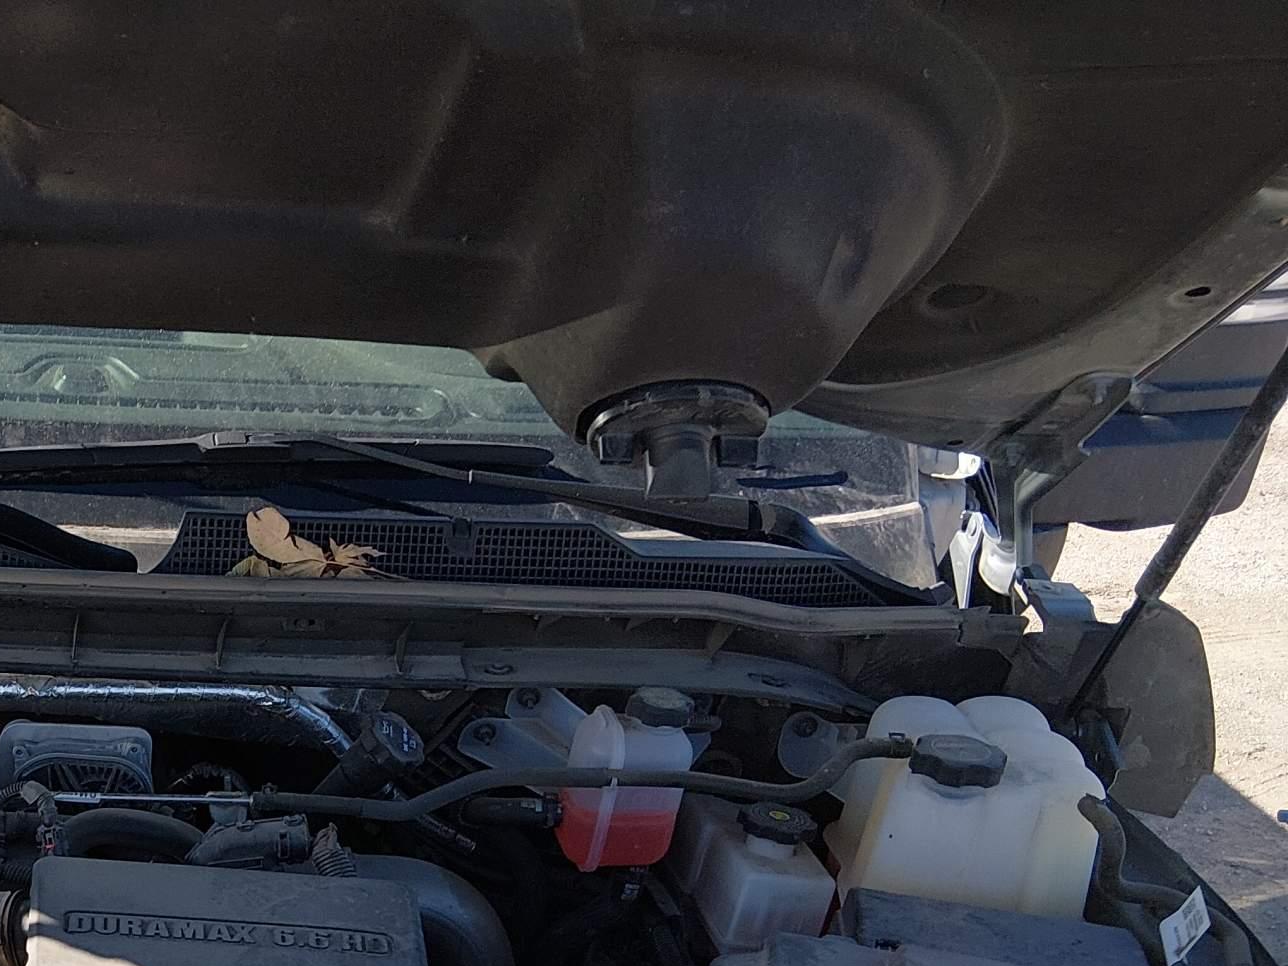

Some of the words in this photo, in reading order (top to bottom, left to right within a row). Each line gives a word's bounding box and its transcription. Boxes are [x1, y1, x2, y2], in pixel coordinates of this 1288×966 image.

[66, 912, 256, 944] DURAMAX
[273, 927, 331, 949] 6.6
[341, 933, 390, 955] HD
